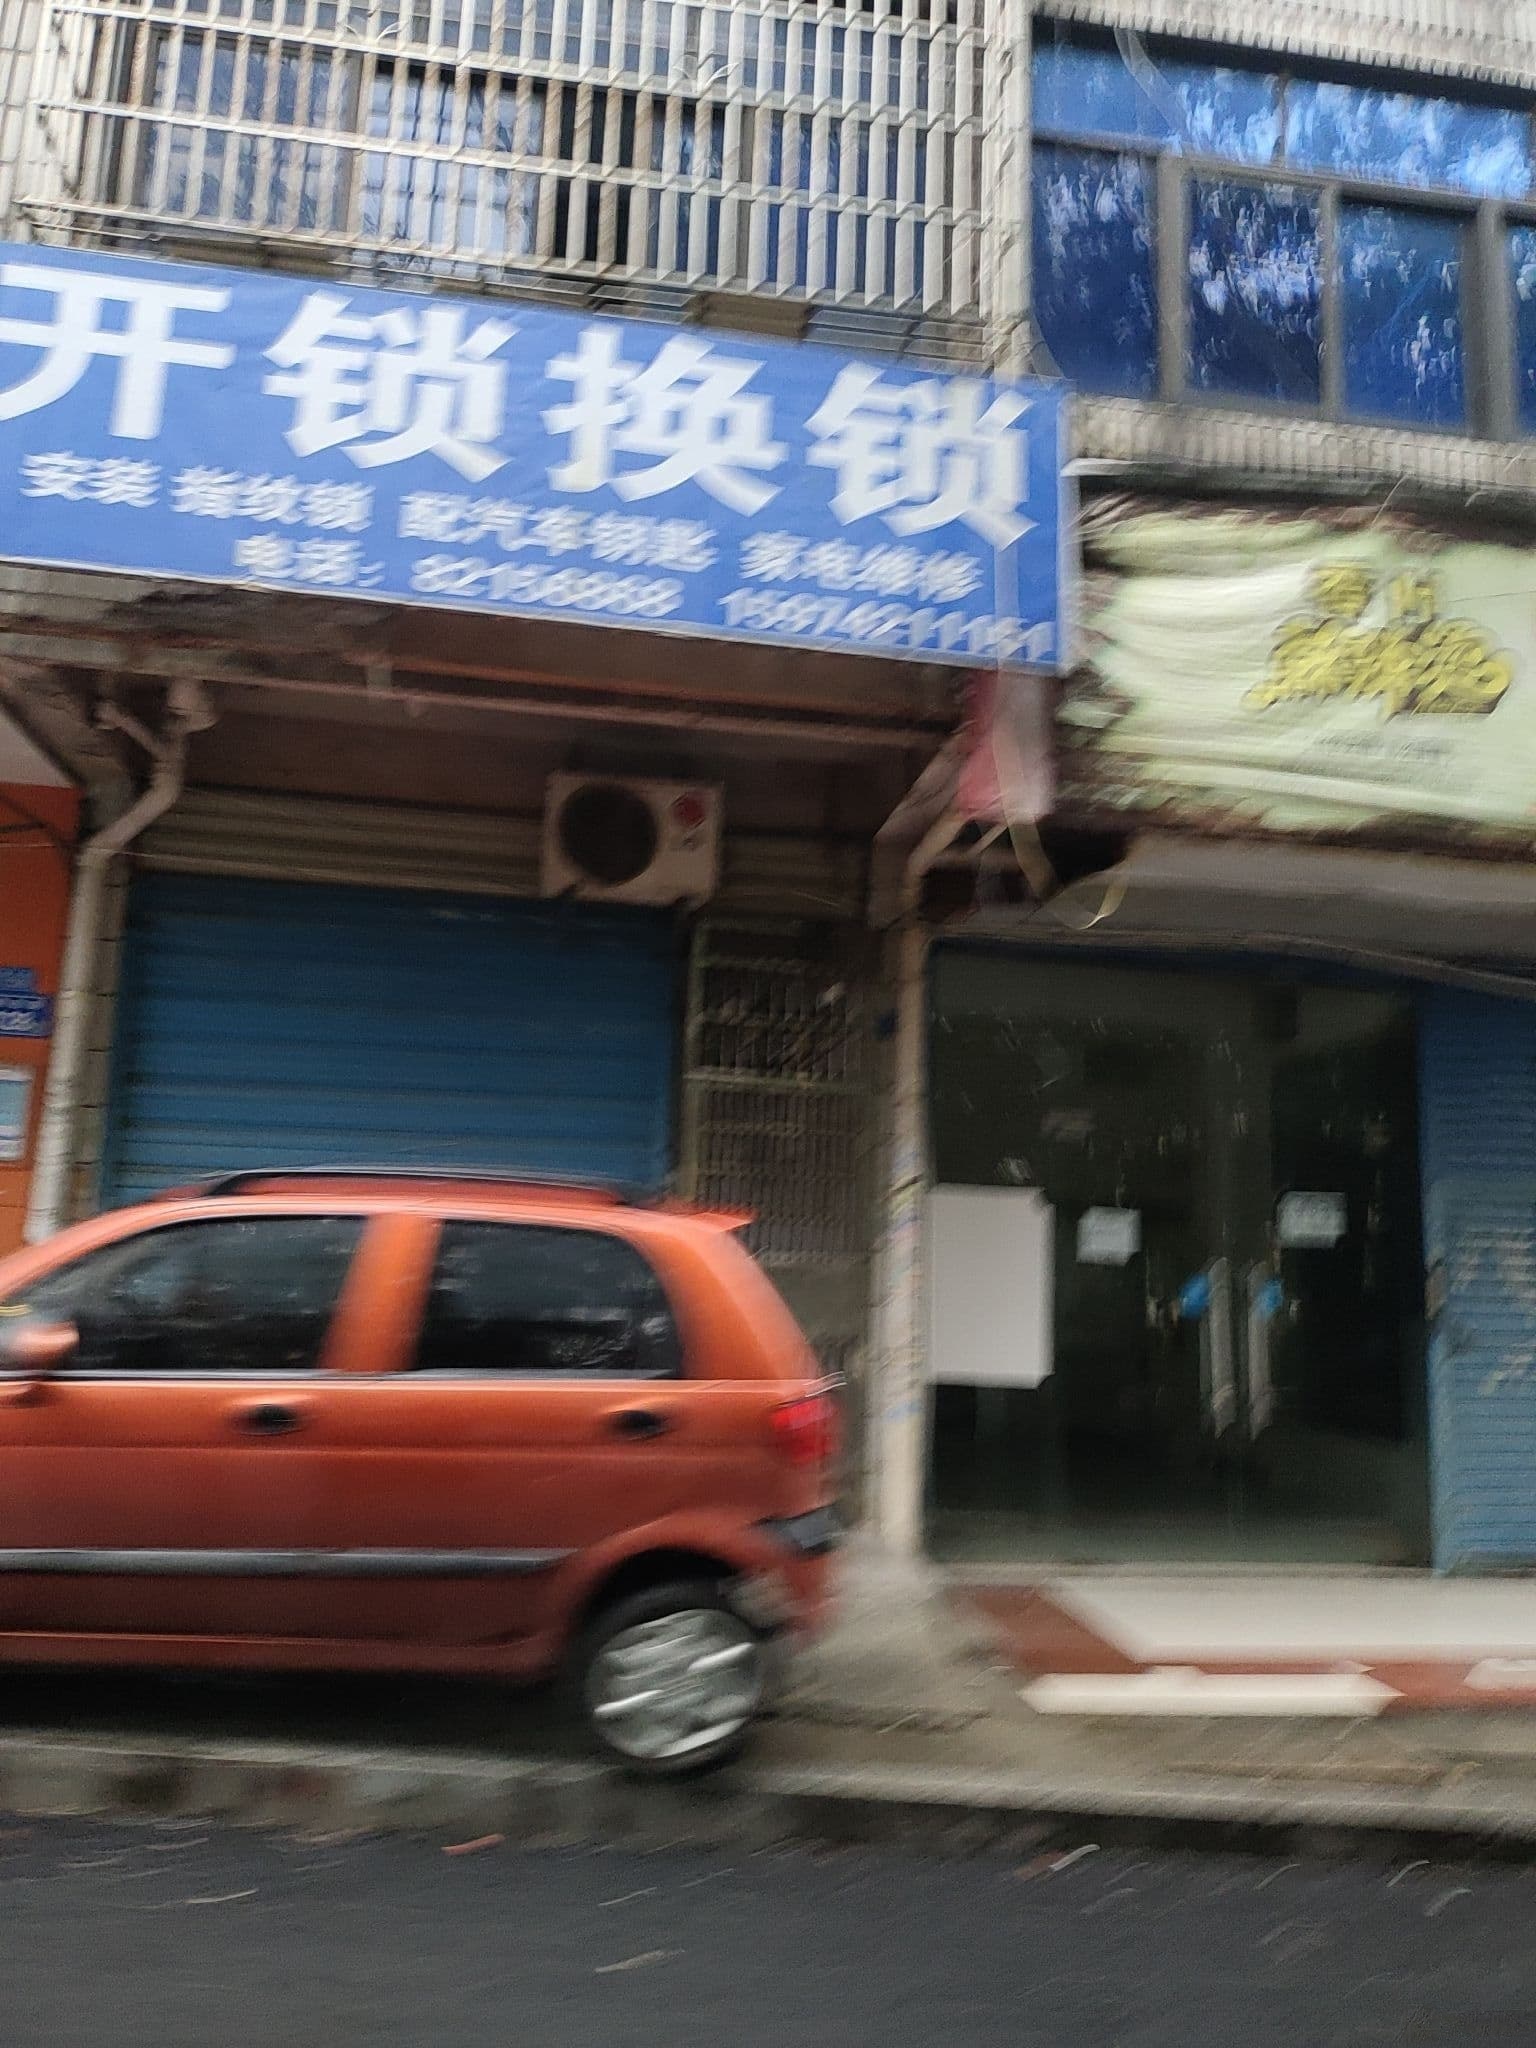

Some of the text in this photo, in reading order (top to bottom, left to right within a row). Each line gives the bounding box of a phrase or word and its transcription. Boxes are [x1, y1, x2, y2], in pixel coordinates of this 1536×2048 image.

[0, 263, 1038, 549] 开锁换锁
[19, 450, 161, 509] 安装
